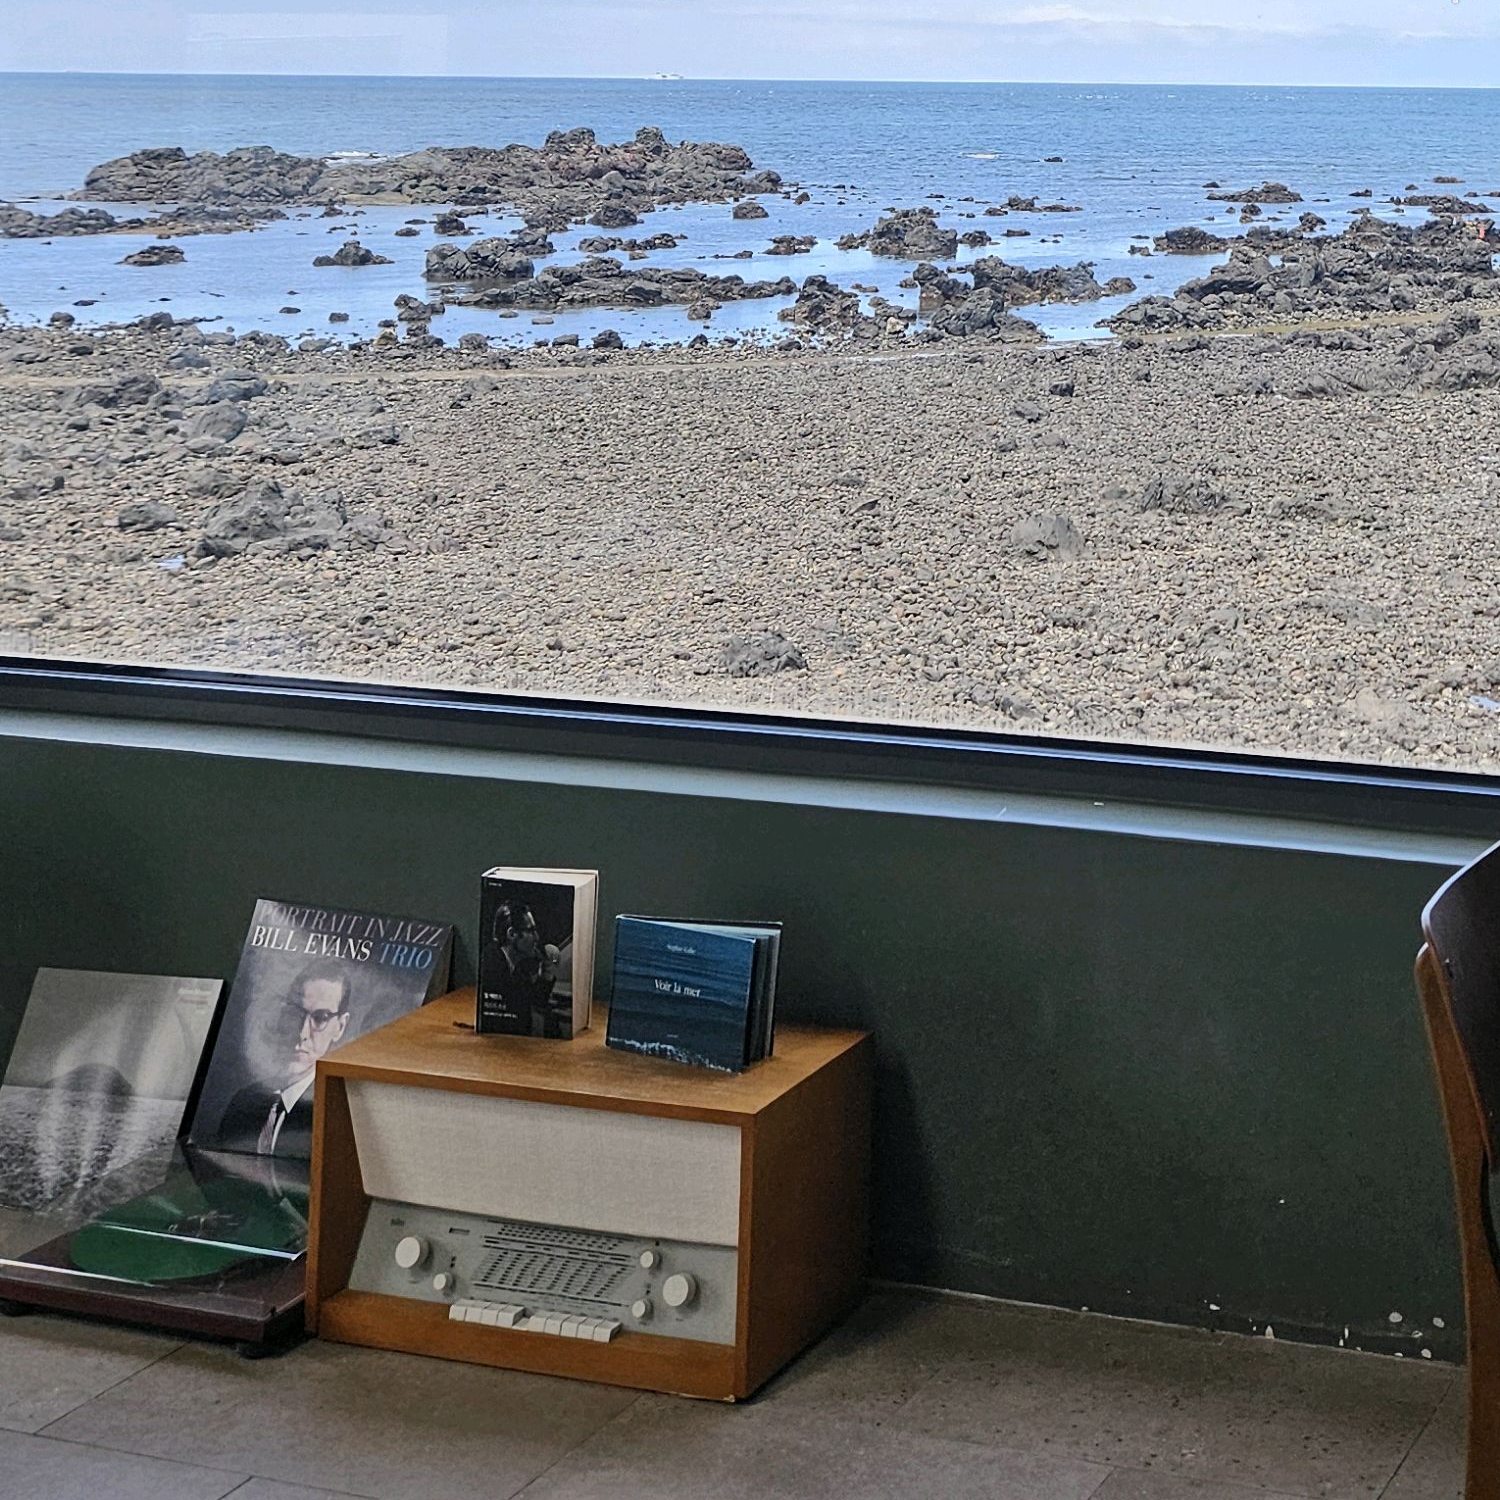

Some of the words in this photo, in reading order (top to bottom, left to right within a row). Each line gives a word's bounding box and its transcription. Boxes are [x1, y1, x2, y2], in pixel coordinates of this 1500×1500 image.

[258, 904, 363, 934] PORTRAIT
[364, 918, 390, 938] IN
[390, 920, 443, 947] JAZZ
[251, 925, 298, 952] BILL
[304, 932, 374, 962] EVANS
[379, 942, 433, 970] TRIO
[654, 978, 672, 992] Voir
[673, 981, 682, 994] la
[683, 986, 701, 998] mer
